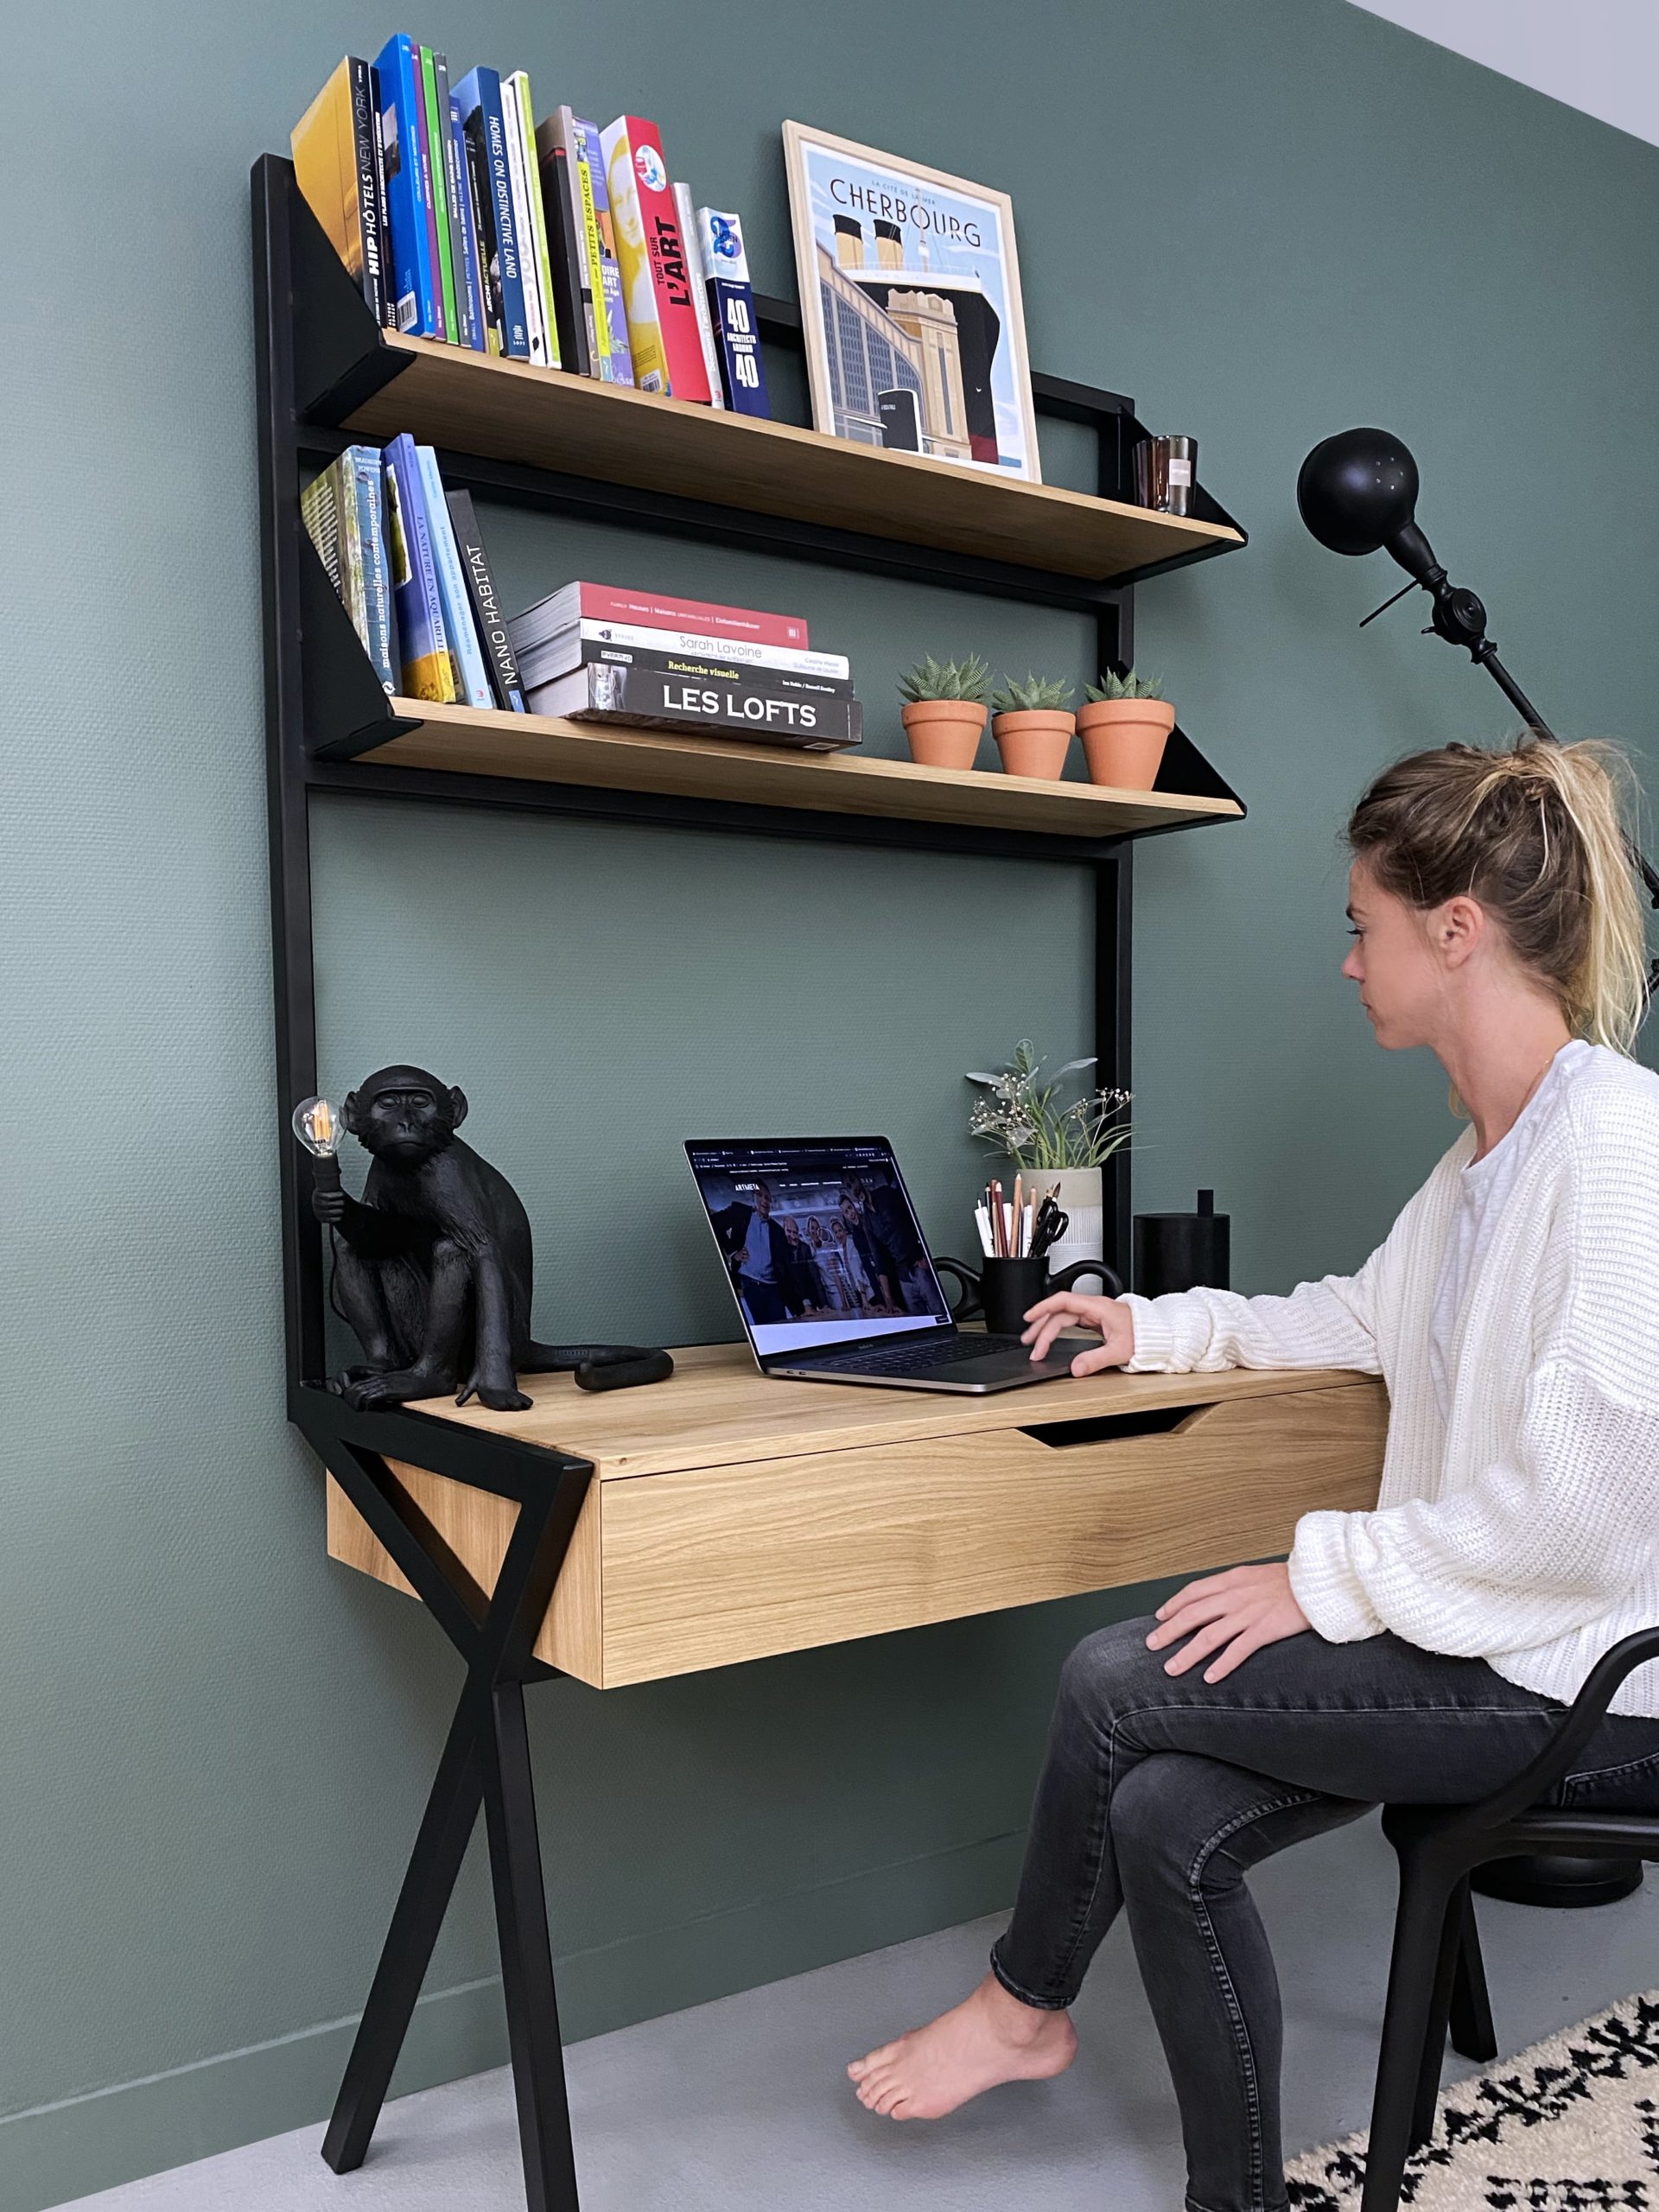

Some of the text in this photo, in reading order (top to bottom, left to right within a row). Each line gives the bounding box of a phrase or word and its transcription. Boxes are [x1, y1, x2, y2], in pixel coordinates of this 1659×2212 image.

[488, 116, 503, 156] HOMES
[355, 86, 379, 276] HIP HÔTELS NEW YORK
[494, 160, 505, 177] ON
[496, 181, 514, 245] DISTINCTIVE
[581, 169, 598, 266] PETITS ESPACES
[830, 179, 981, 247] CHERBOURG
[504, 249, 517, 278] LAND
[650, 237, 666, 285] TOUT SUR
[655, 216, 692, 307] L'ART
[727, 297, 751, 334] 40
[735, 354, 760, 388] 40
[367, 480, 389, 669] maisons naturelles contemporaines
[440, 526, 457, 581] appartement
[416, 516, 445, 657] LA NATURE EN AQUARELLE
[628, 603, 650, 613] Houses
[654, 607, 677, 617] Maisons
[455, 602, 473, 654] Réaménager
[466, 544, 518, 685] NANO HABITAT
[668, 661, 740, 679] Recherche visuelle
[679, 635, 714, 652] Sarah
[716, 639, 762, 659] Lavoine
[663, 684, 817, 727] LES LOFTS
